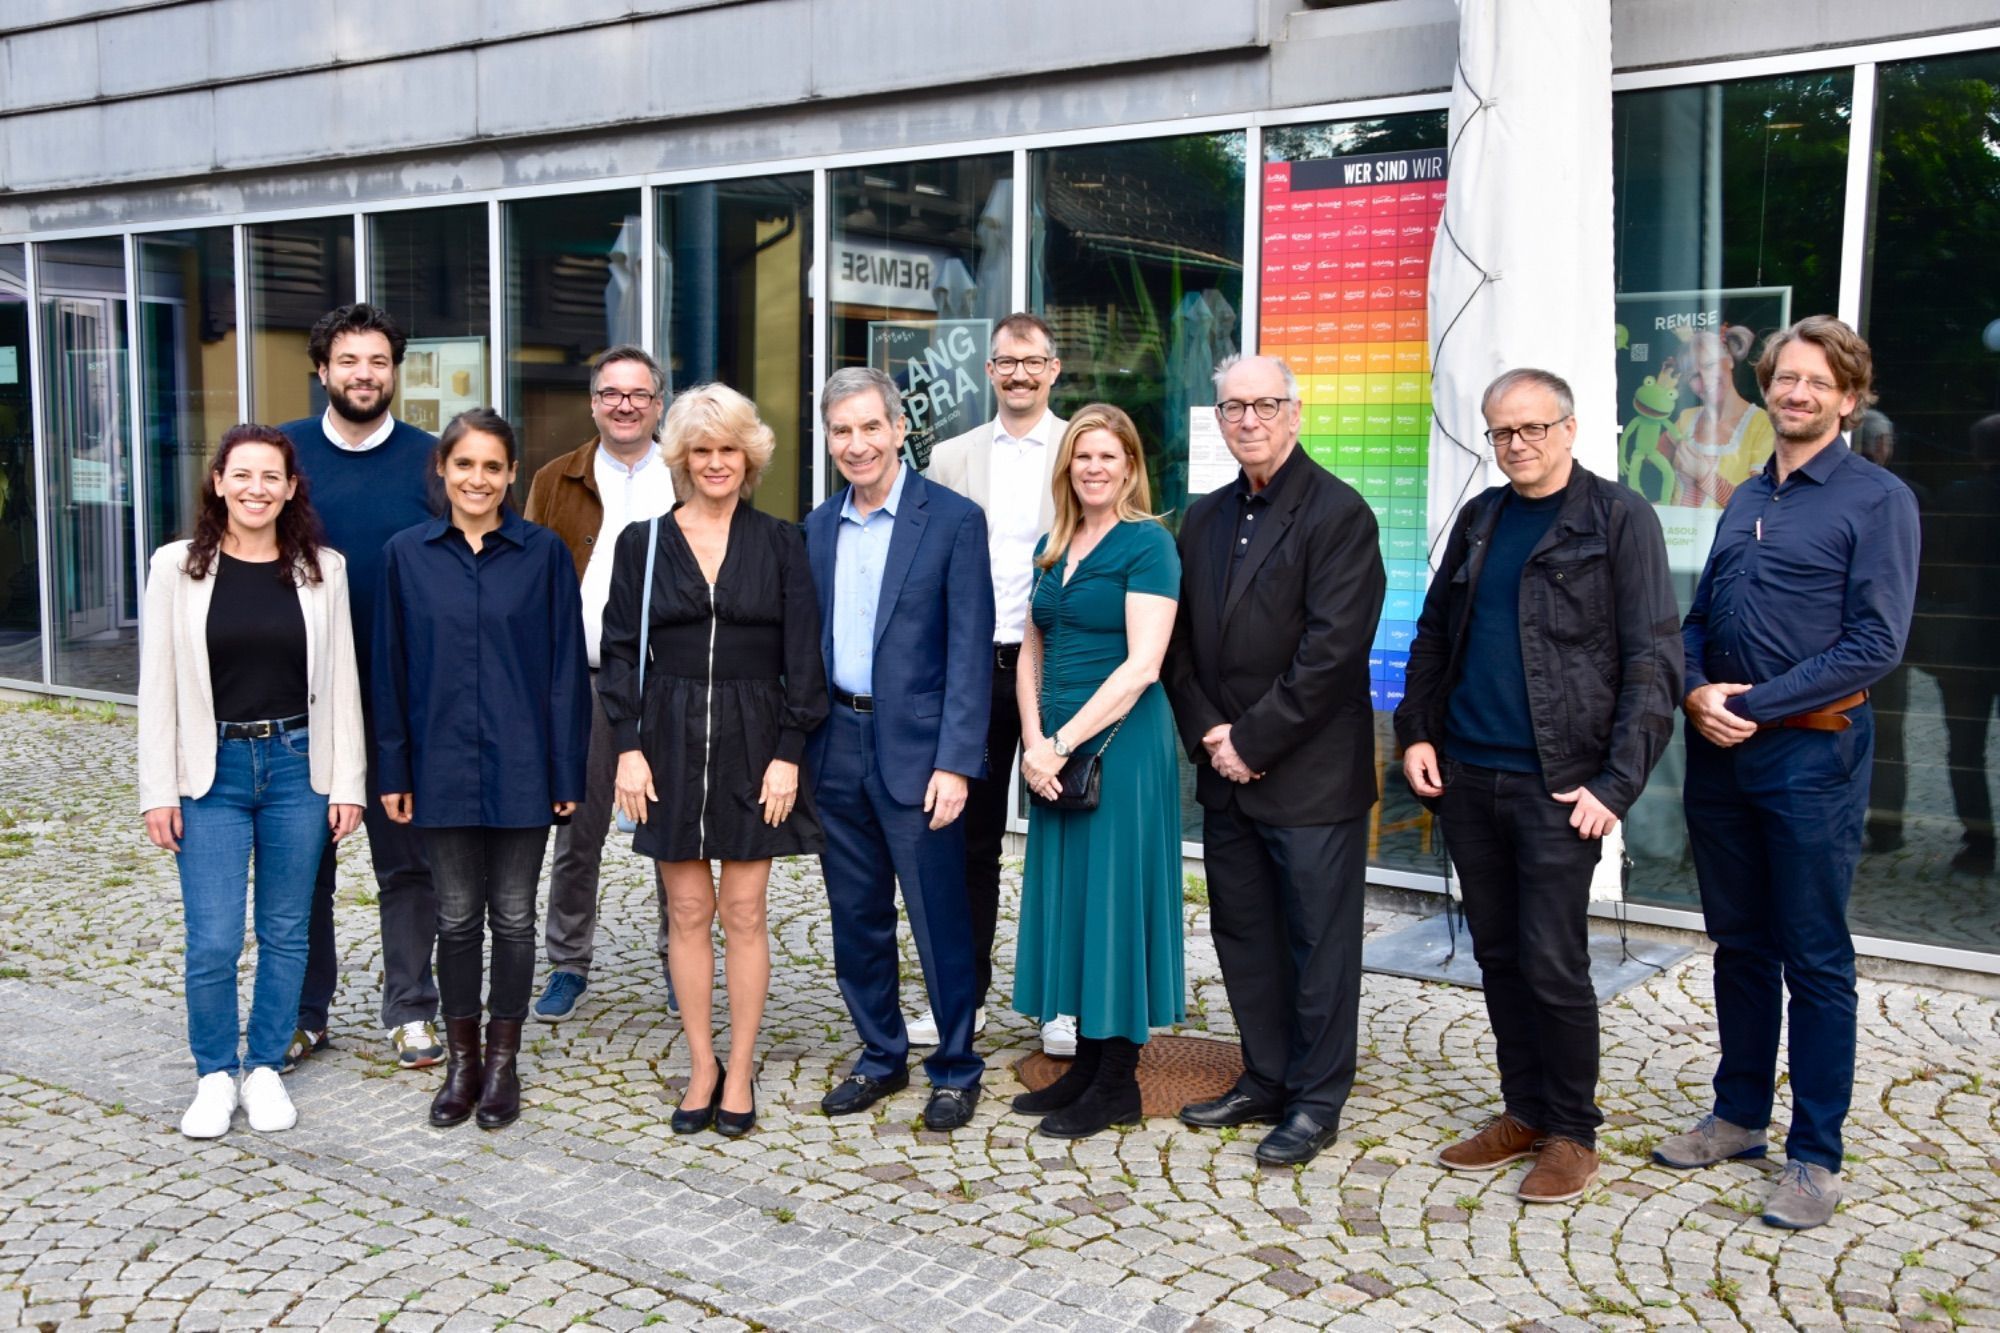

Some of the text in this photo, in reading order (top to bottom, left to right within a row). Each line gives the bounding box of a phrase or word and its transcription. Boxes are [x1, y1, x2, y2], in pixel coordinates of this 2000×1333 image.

[1344, 157, 1442, 184] WER SIND WIR
[1655, 310, 1718, 330] REMISE
[901, 326, 977, 401] ANG
